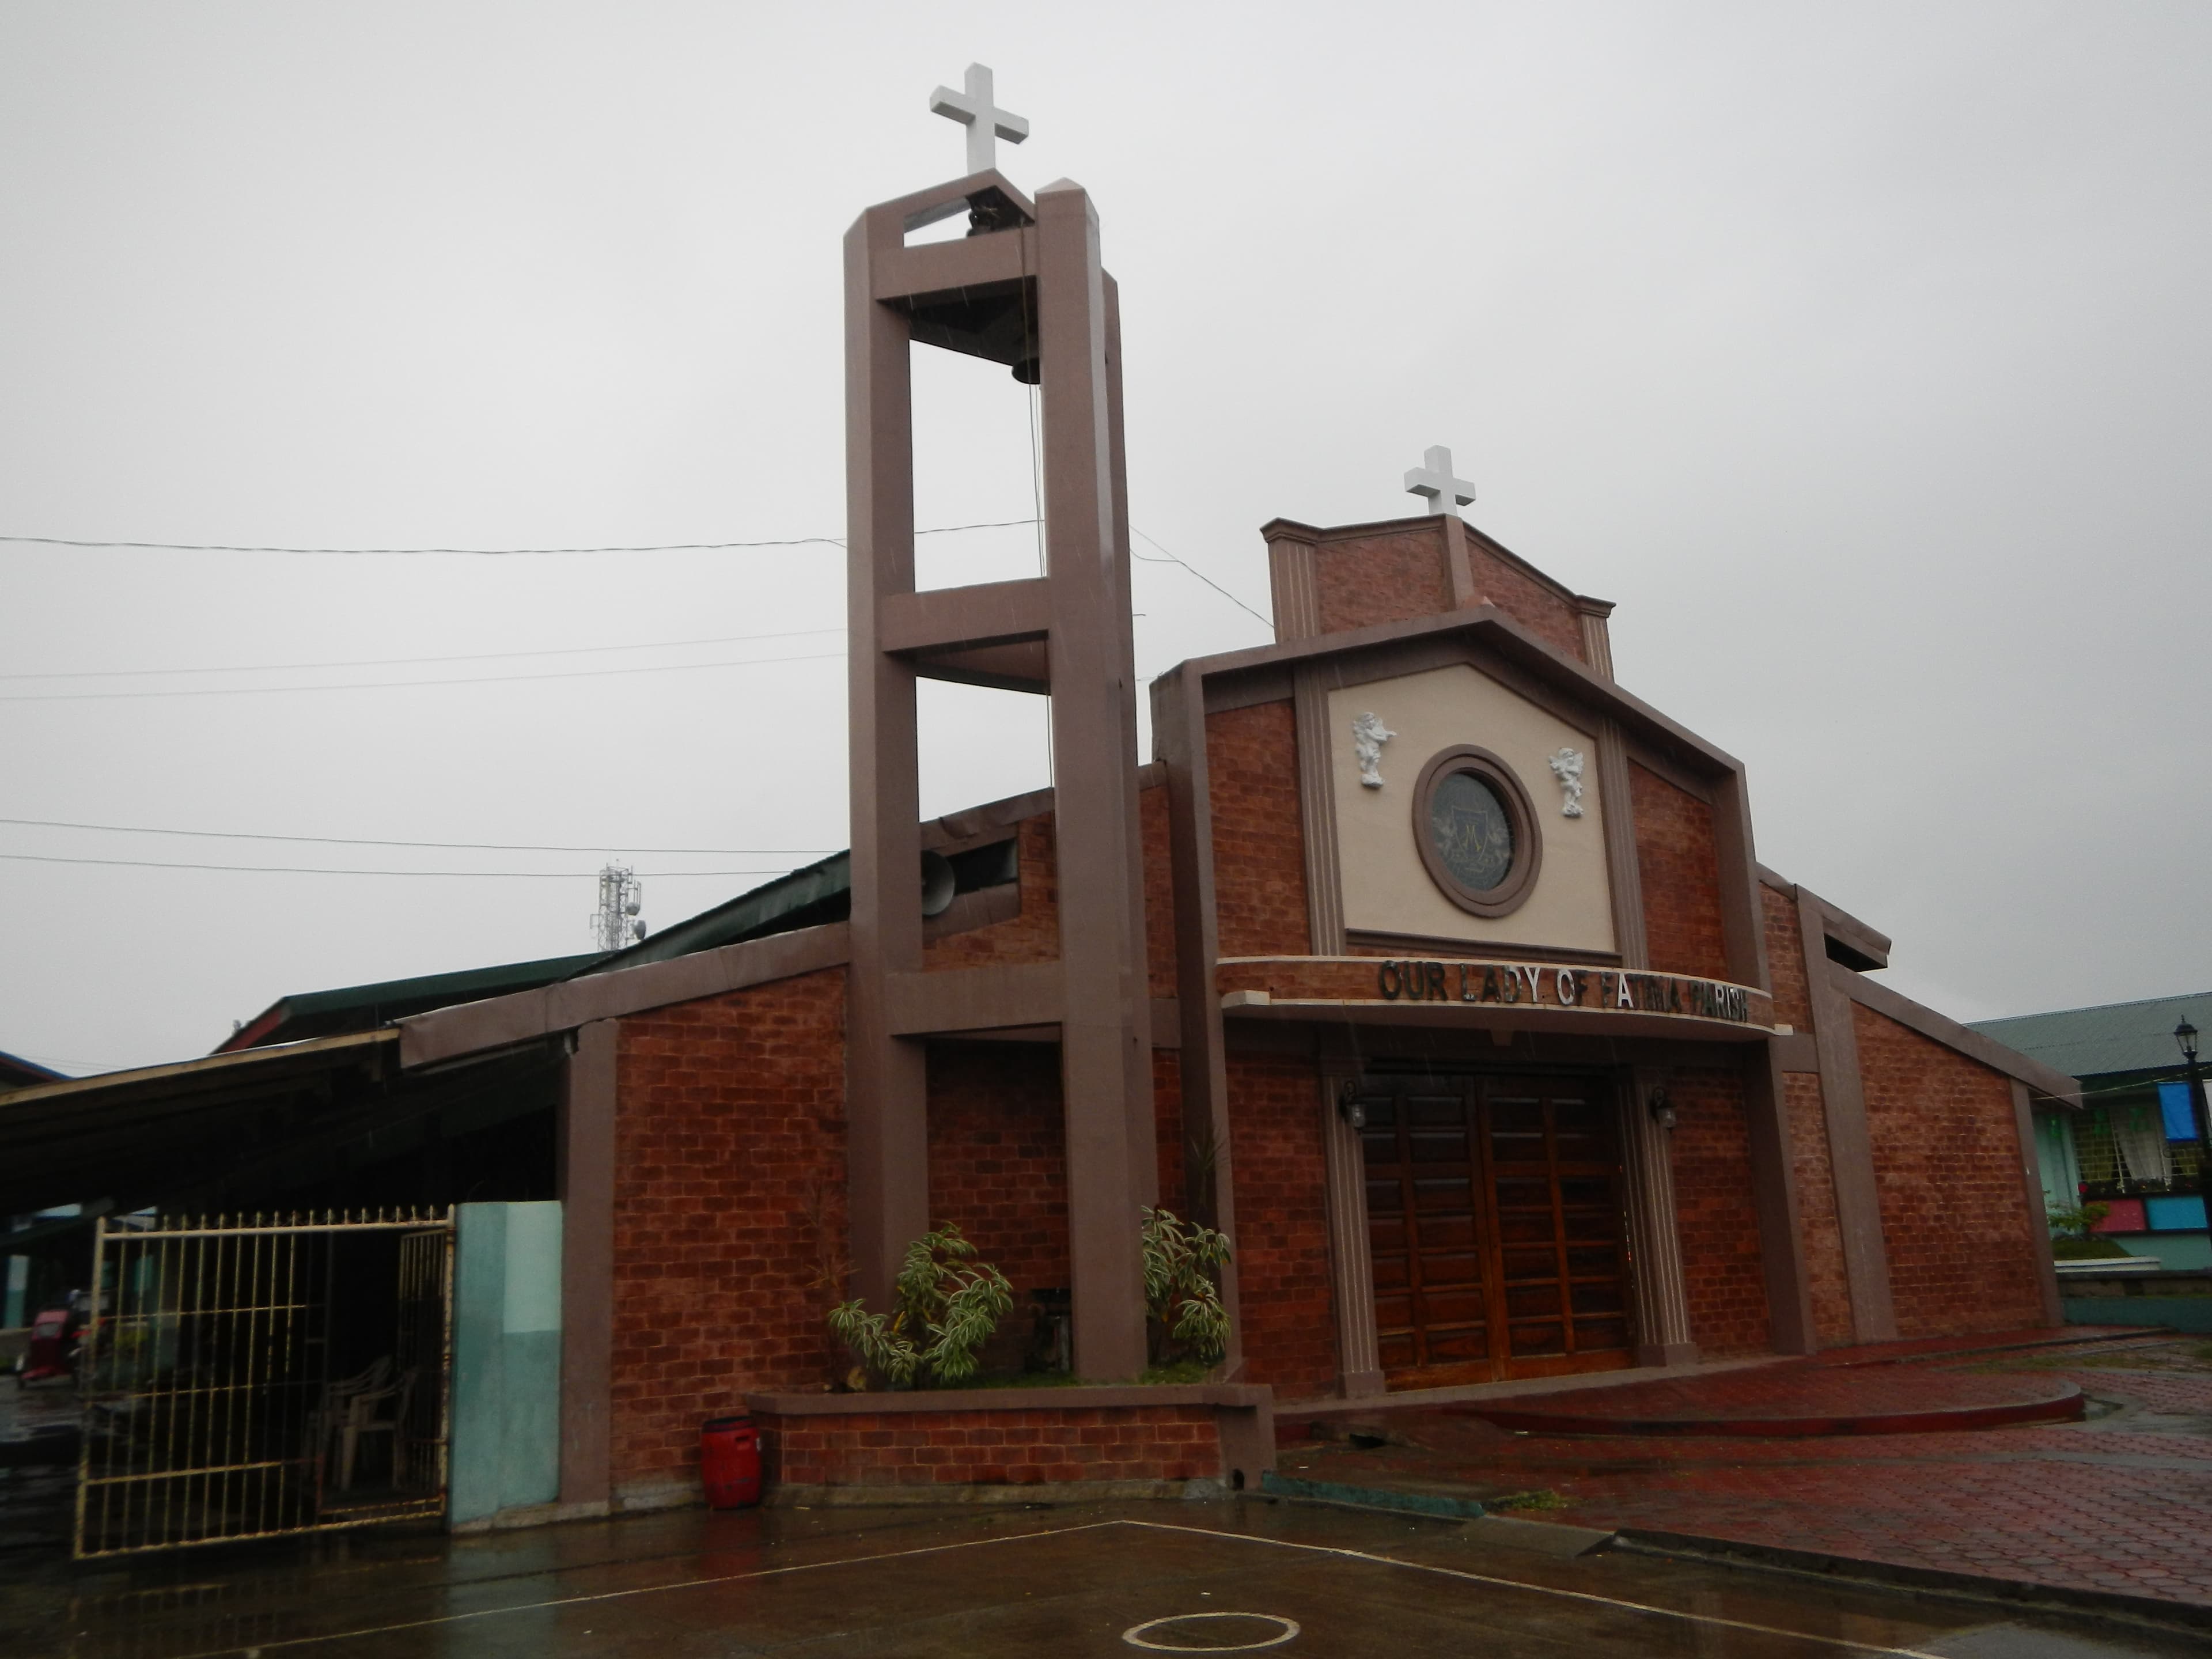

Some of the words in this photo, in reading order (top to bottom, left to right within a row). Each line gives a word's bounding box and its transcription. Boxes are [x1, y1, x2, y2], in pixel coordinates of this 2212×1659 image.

[1380, 960, 1448, 1001] OUR
[1459, 963, 1541, 1003] LADY
[1556, 968, 1588, 1006] OF
[1600, 971, 1682, 1014] FATIMA
[1688, 979, 1748, 1023] PARISH
